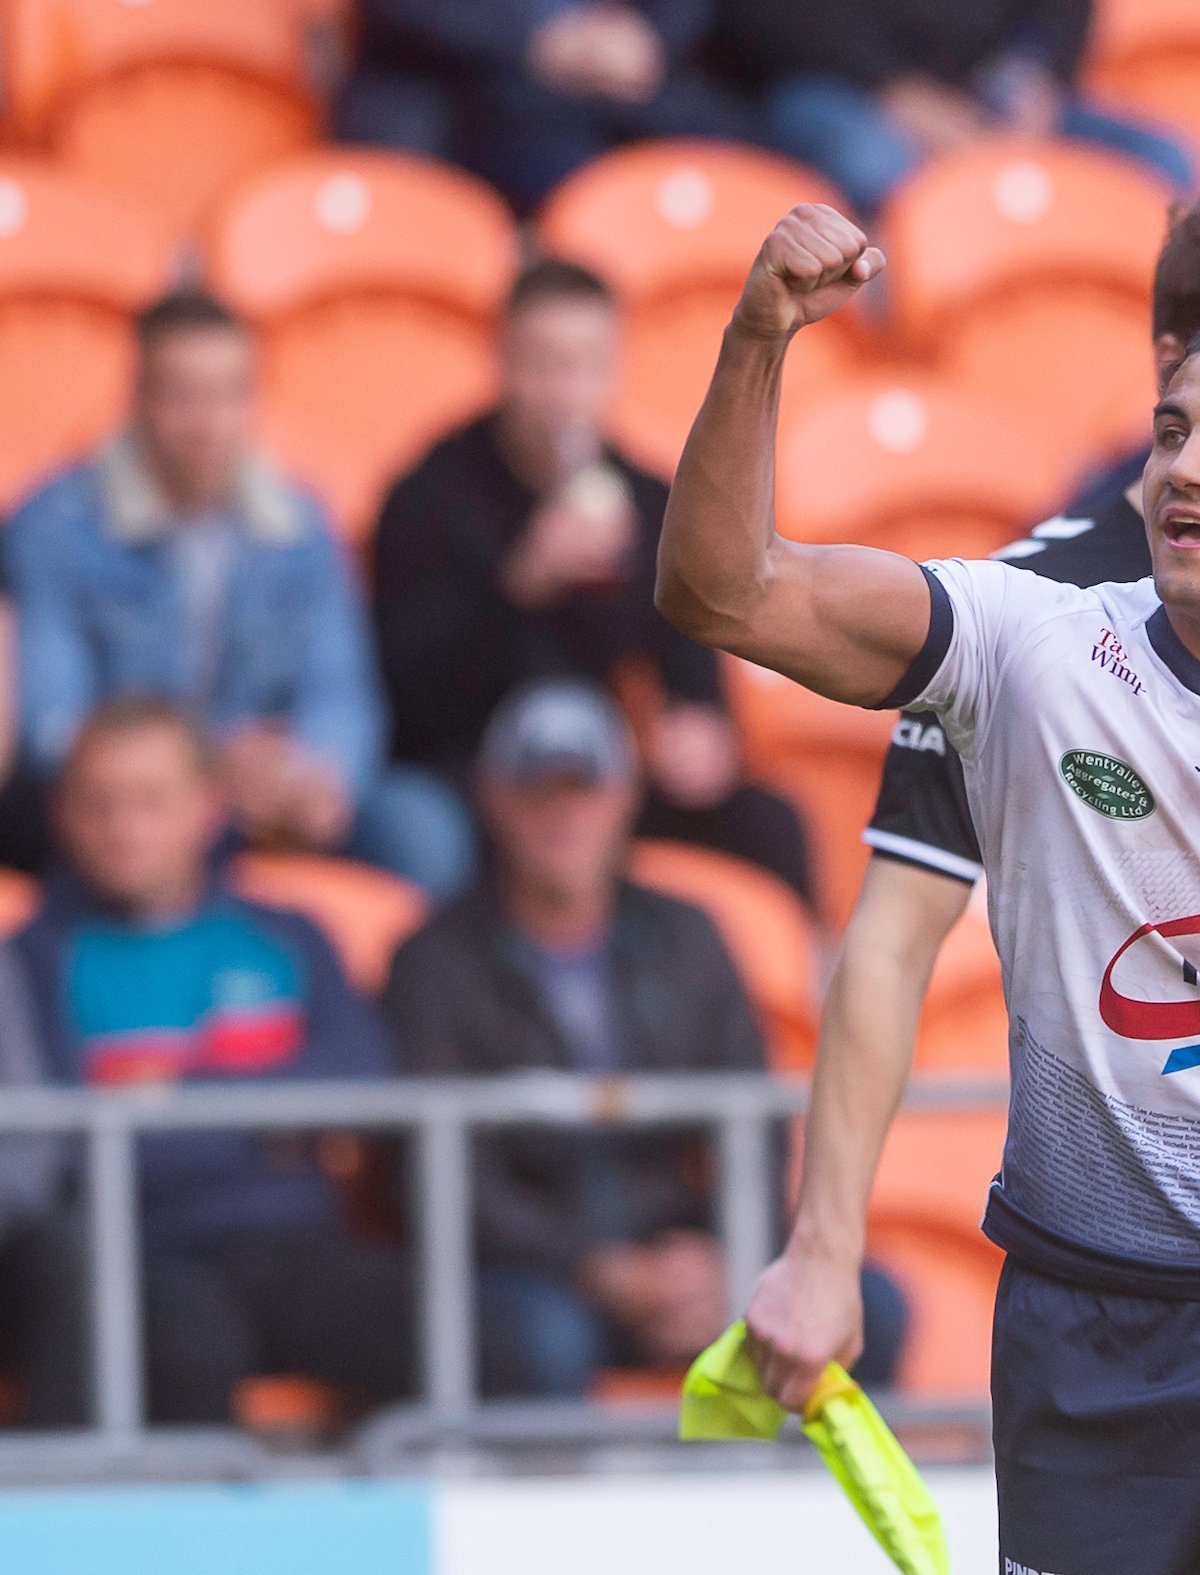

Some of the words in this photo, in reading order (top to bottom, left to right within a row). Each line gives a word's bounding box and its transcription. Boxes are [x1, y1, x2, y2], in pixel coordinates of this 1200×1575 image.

[1065, 772, 1117, 816] Recycling
[1121, 805, 1144, 816] Ltd
[1066, 763, 1137, 802] Aggregates
[1072, 753, 1147, 796] Wentvalley
